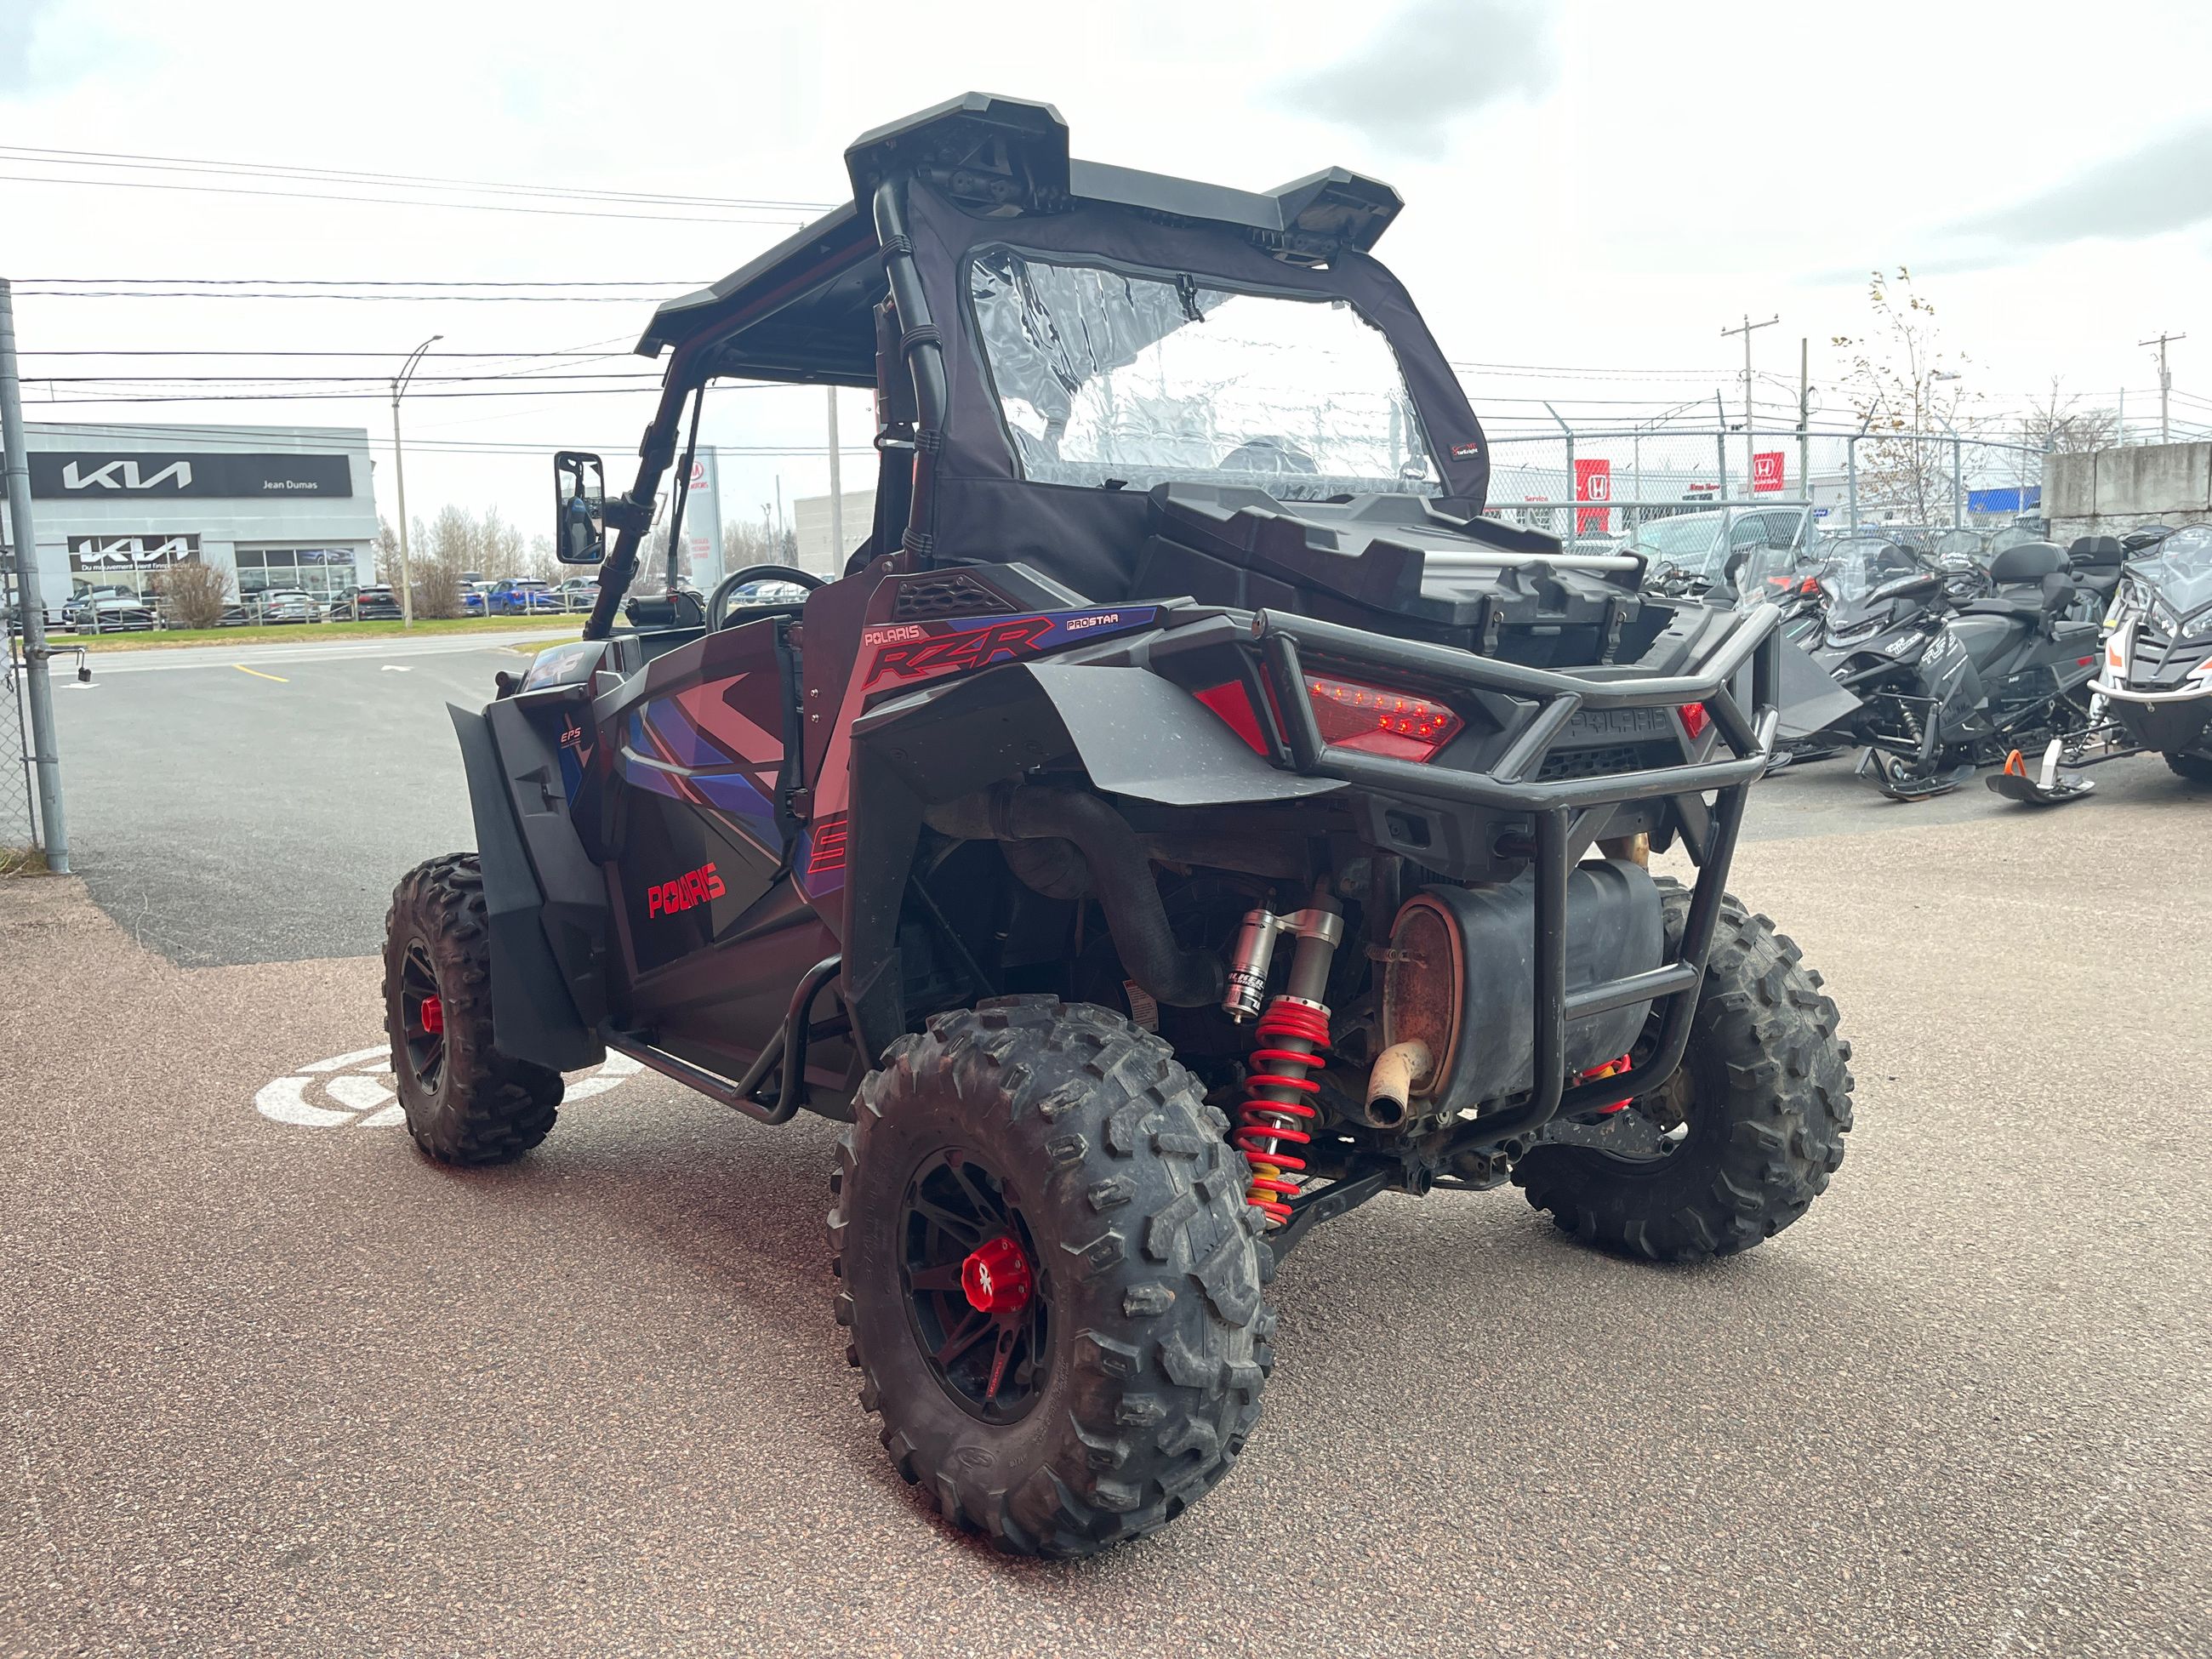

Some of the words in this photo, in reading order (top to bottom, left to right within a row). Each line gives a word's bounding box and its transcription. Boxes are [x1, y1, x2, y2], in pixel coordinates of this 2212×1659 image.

[62, 460, 192, 489] KIA
[263, 480, 285, 489] Jean
[286, 480, 318, 489] Dumas
[79, 538, 189, 562] KIA
[1066, 613, 1119, 630] PROSTAR
[864, 625, 920, 647] POLARIS
[860, 616, 1056, 692] RZR
[561, 727, 582, 743] EPS
[1571, 709, 1668, 738] POLARIS
[647, 862, 726, 919] POLARIS
